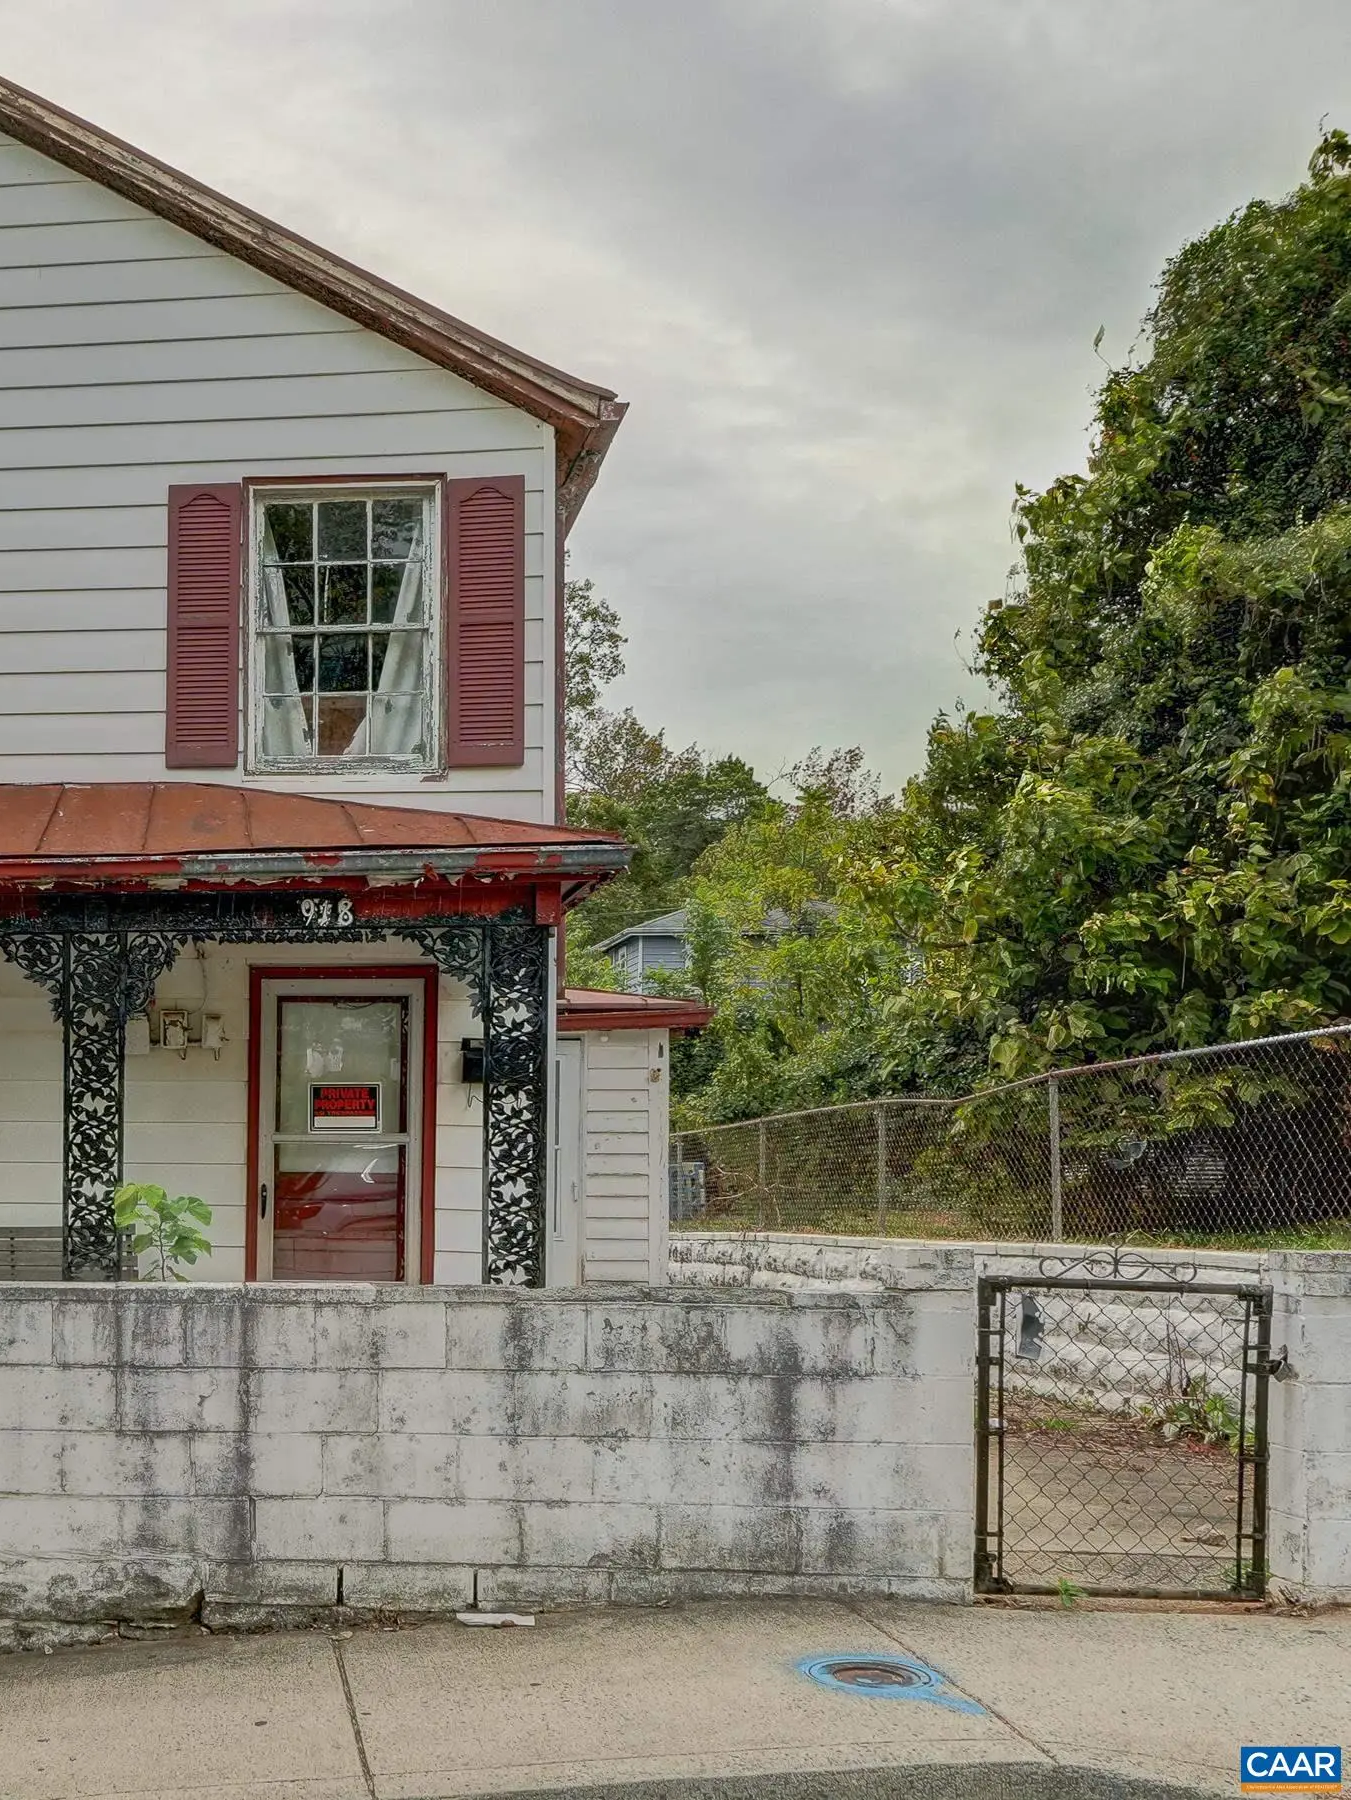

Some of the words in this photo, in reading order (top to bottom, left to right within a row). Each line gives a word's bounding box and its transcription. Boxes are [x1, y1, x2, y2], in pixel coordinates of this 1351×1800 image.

[301, 898, 354, 927] 918
[321, 1087, 369, 1099] PRIVATE
[314, 1099, 376, 1110] PROPERTY
